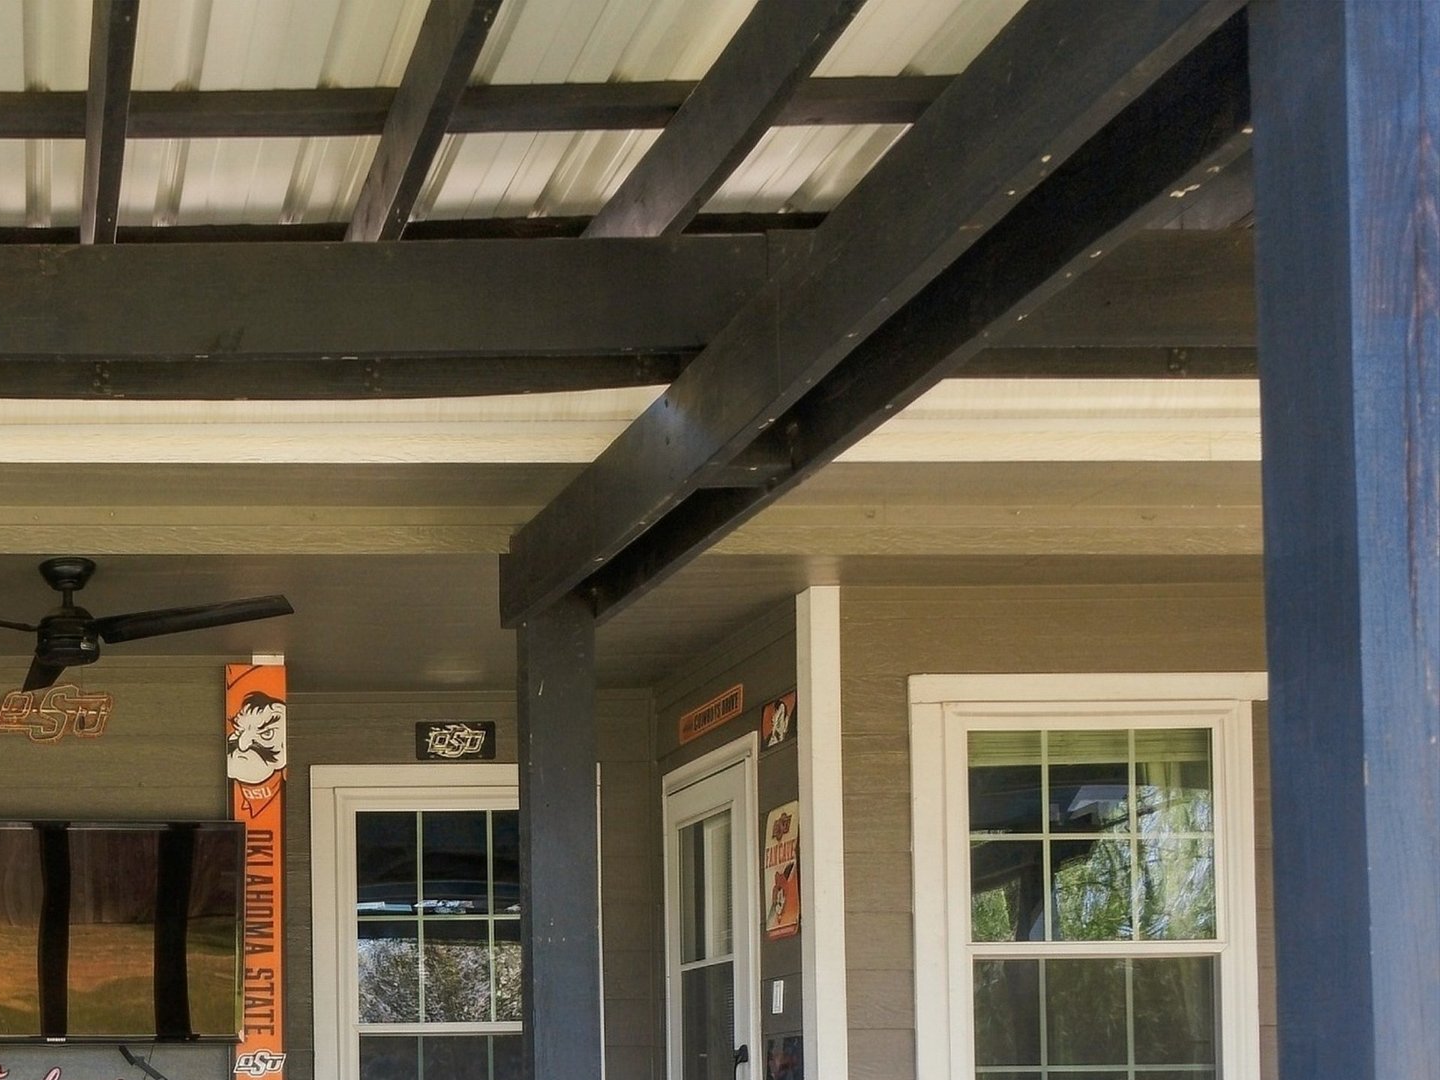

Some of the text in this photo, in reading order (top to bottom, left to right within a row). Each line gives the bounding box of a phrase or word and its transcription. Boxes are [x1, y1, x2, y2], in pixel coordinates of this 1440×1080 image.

[242, 787, 271, 799] OSU
[244, 967, 274, 1036] STATE
[234, 1050, 286, 1077] OSU
